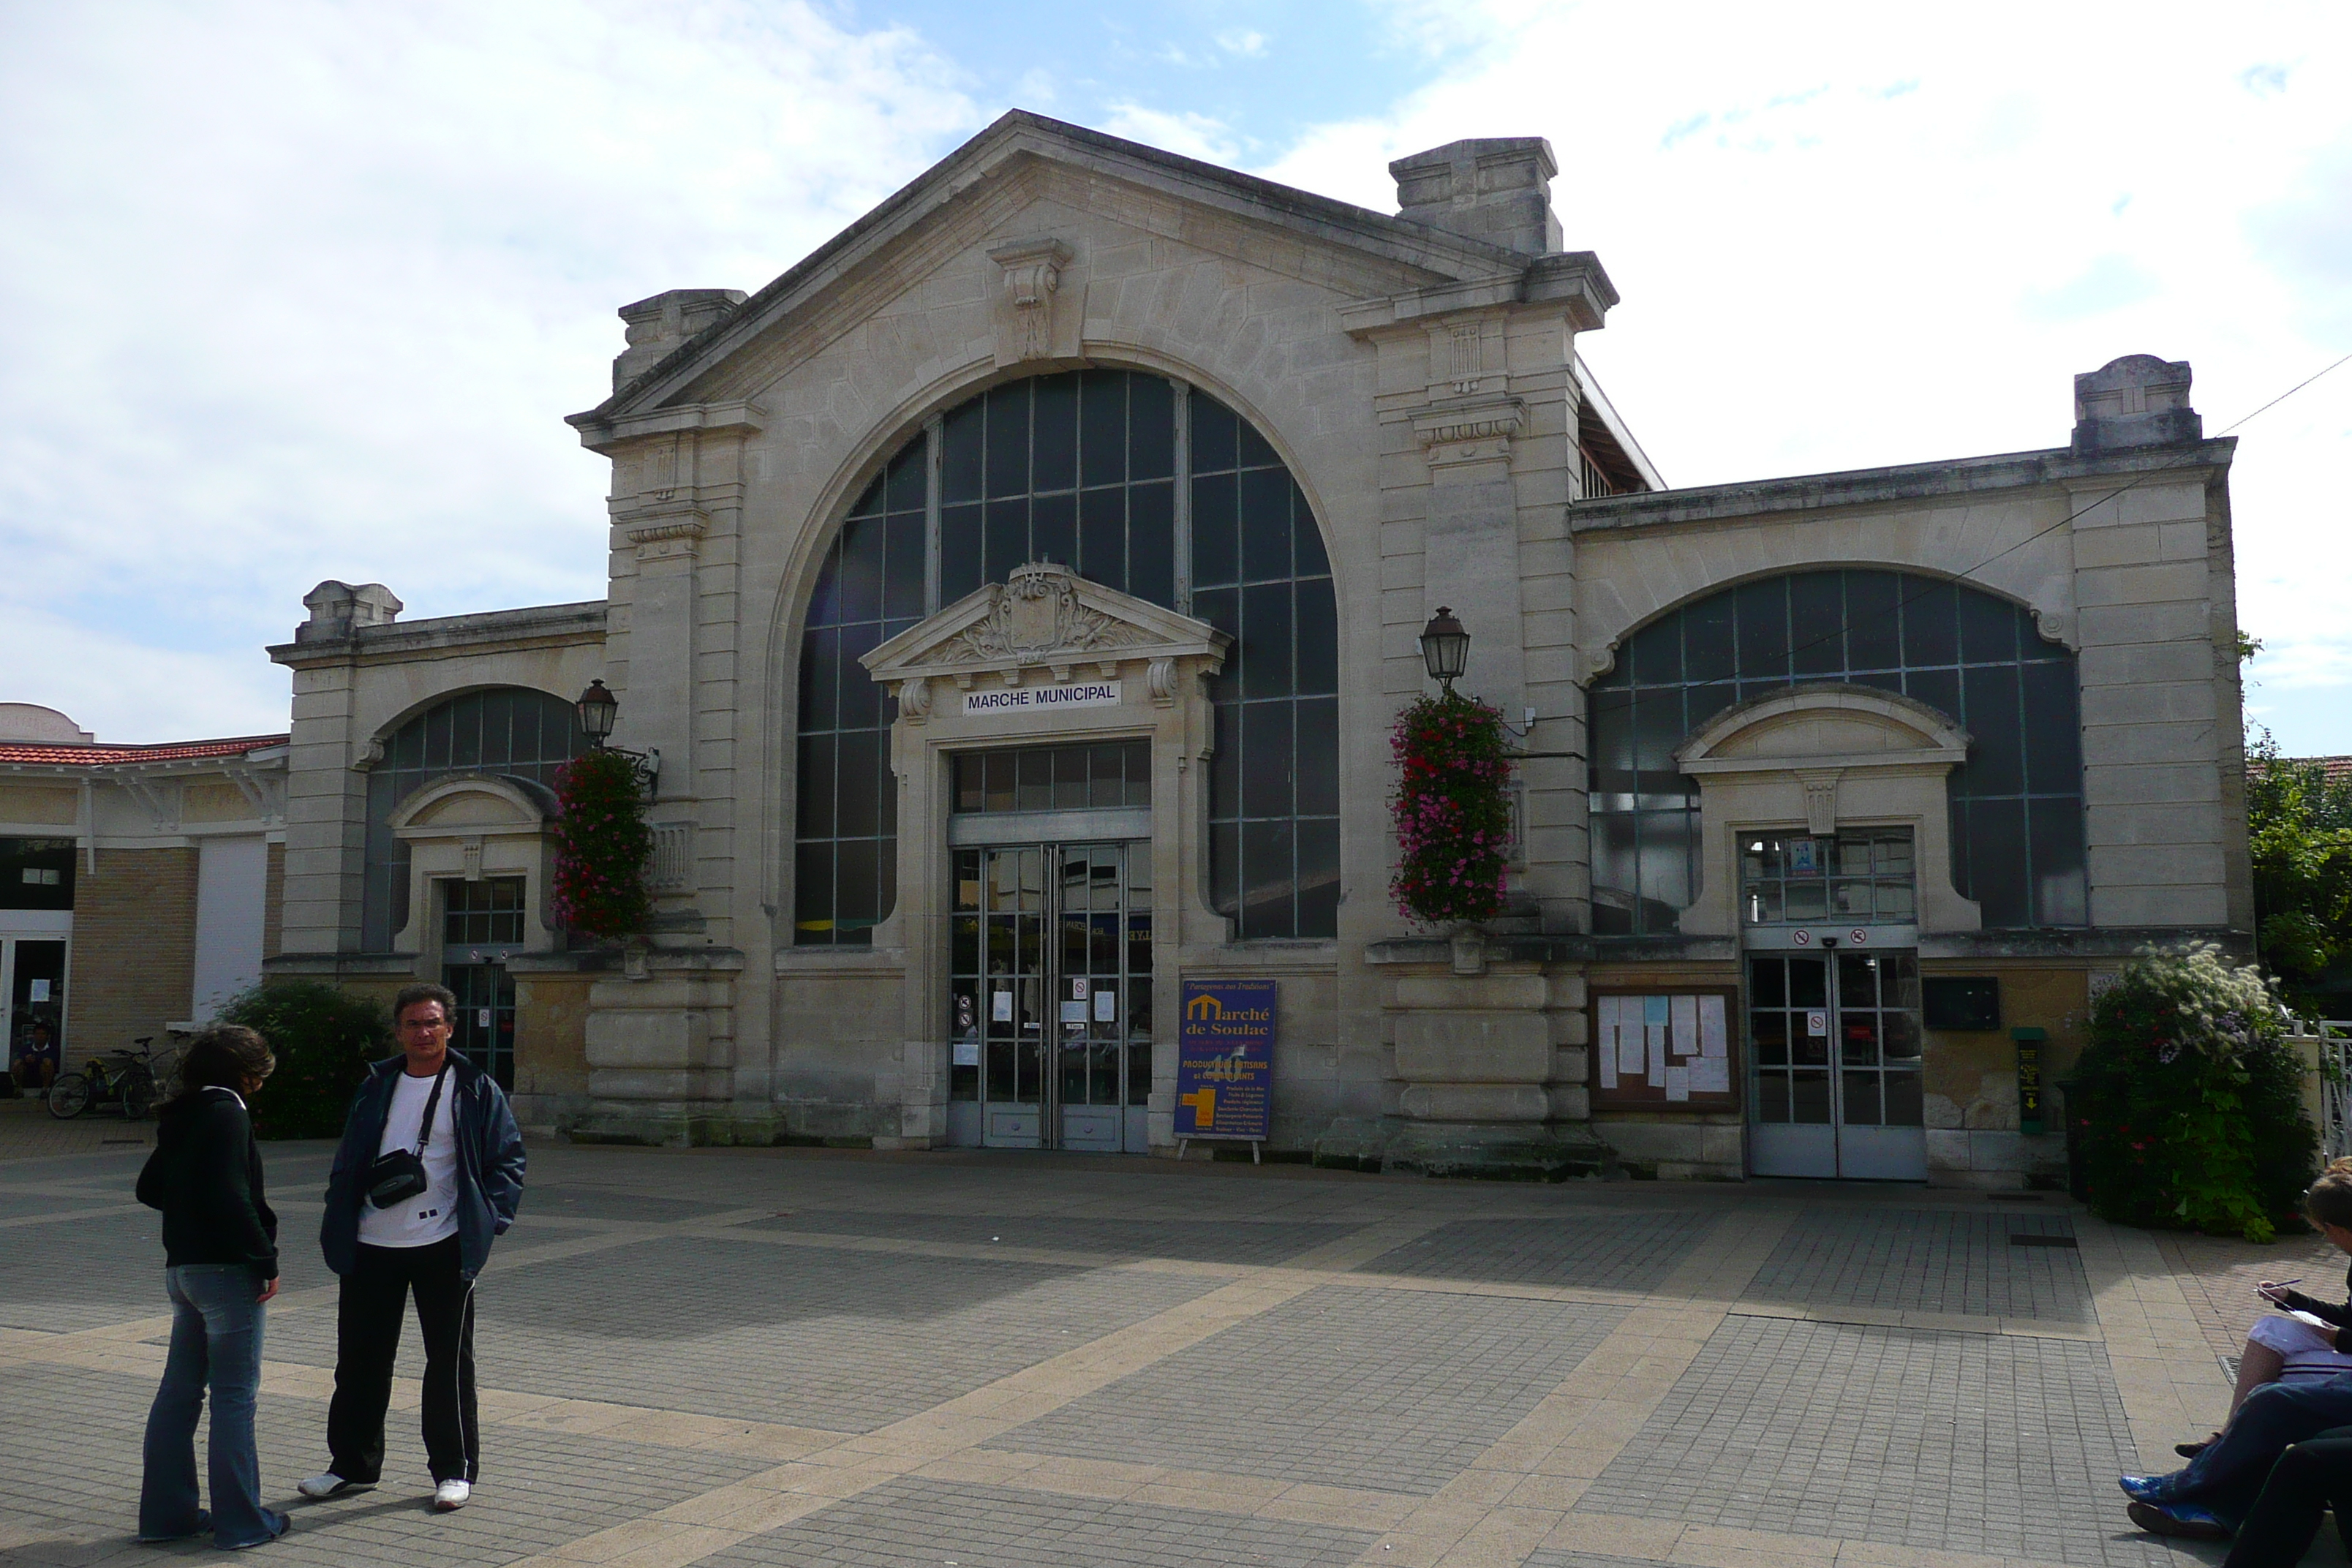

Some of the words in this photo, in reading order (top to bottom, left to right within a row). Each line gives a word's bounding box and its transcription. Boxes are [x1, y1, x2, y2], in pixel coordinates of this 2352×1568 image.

[1036, 685, 1115, 704] MUNICIPAL
[1187, 993, 1270, 1020] Marché
[1186, 1023, 1206, 1035] de
[1211, 1023, 1268, 1035] Soulac
